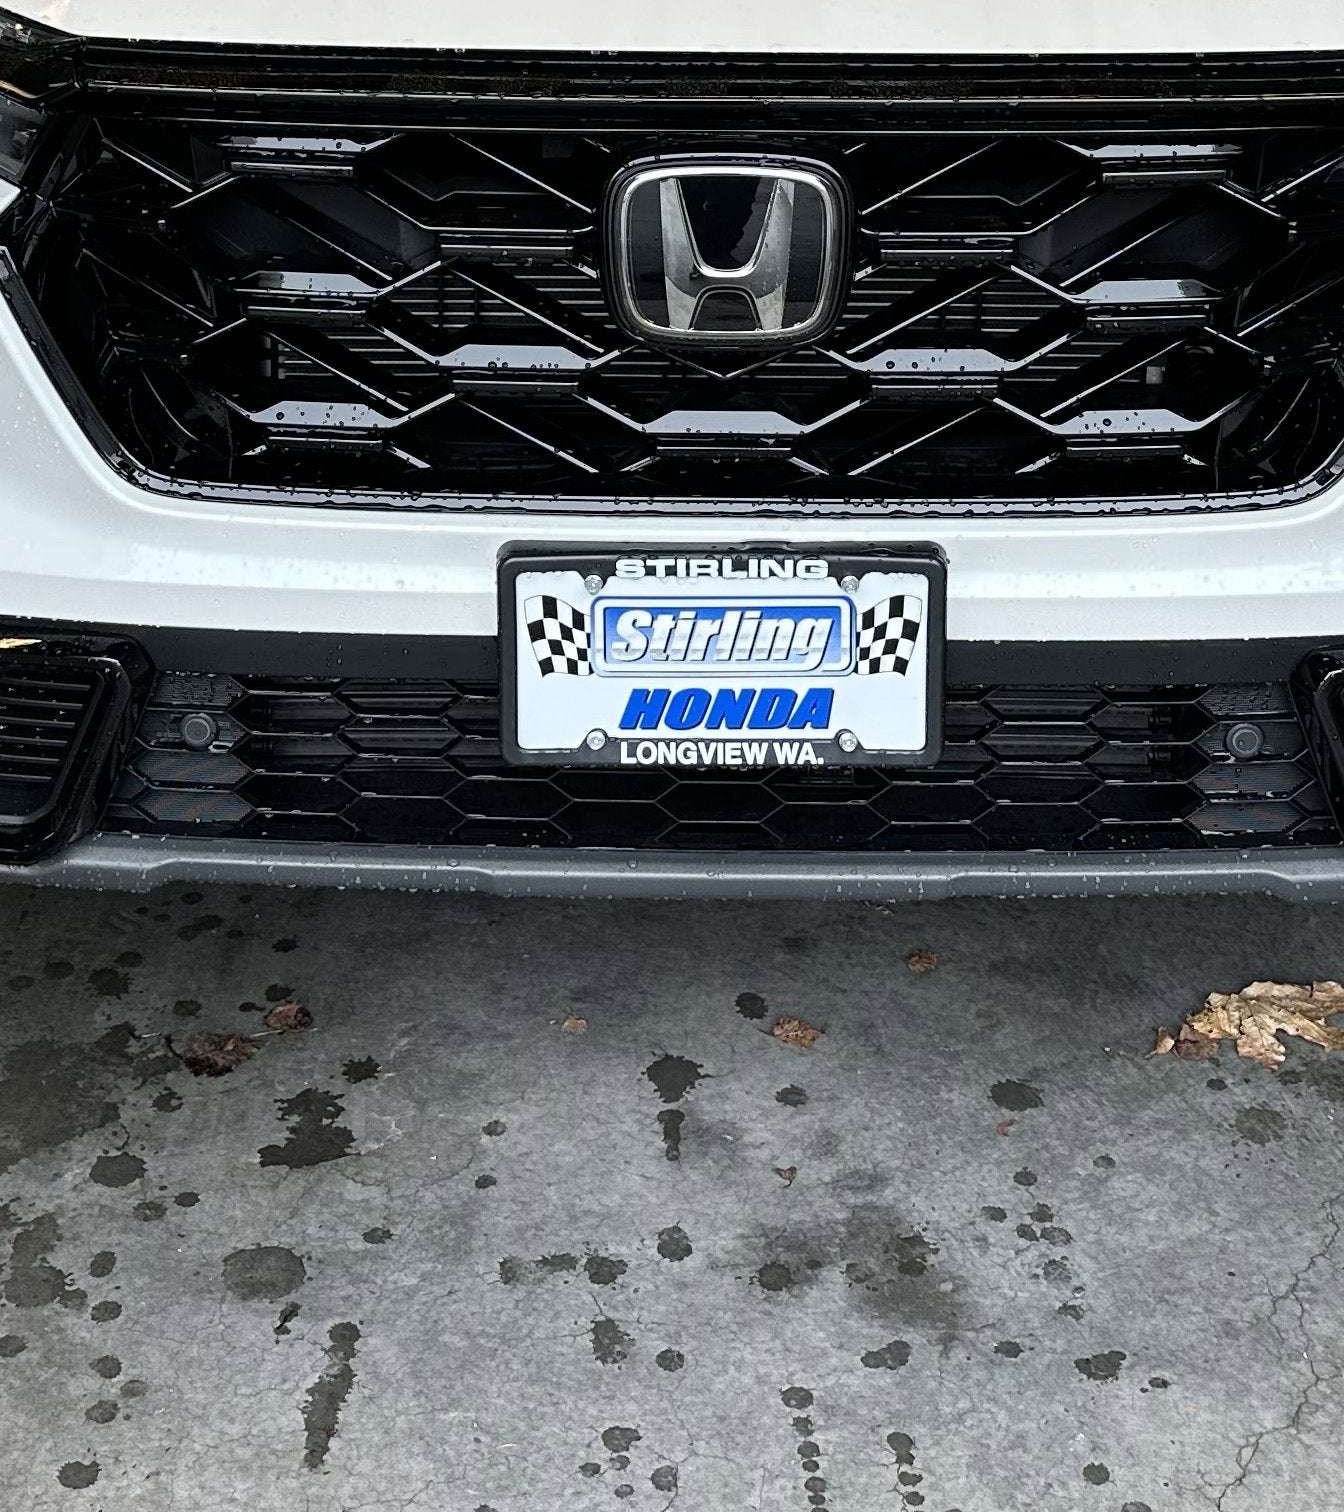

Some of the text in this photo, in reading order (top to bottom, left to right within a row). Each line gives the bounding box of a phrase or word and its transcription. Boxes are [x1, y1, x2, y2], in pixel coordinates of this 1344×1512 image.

[615, 558, 830, 579] STIRLING
[611, 609, 835, 670] Stirling
[618, 688, 835, 730] HONDA
[620, 741, 825, 765] LONGVIEW WA.
